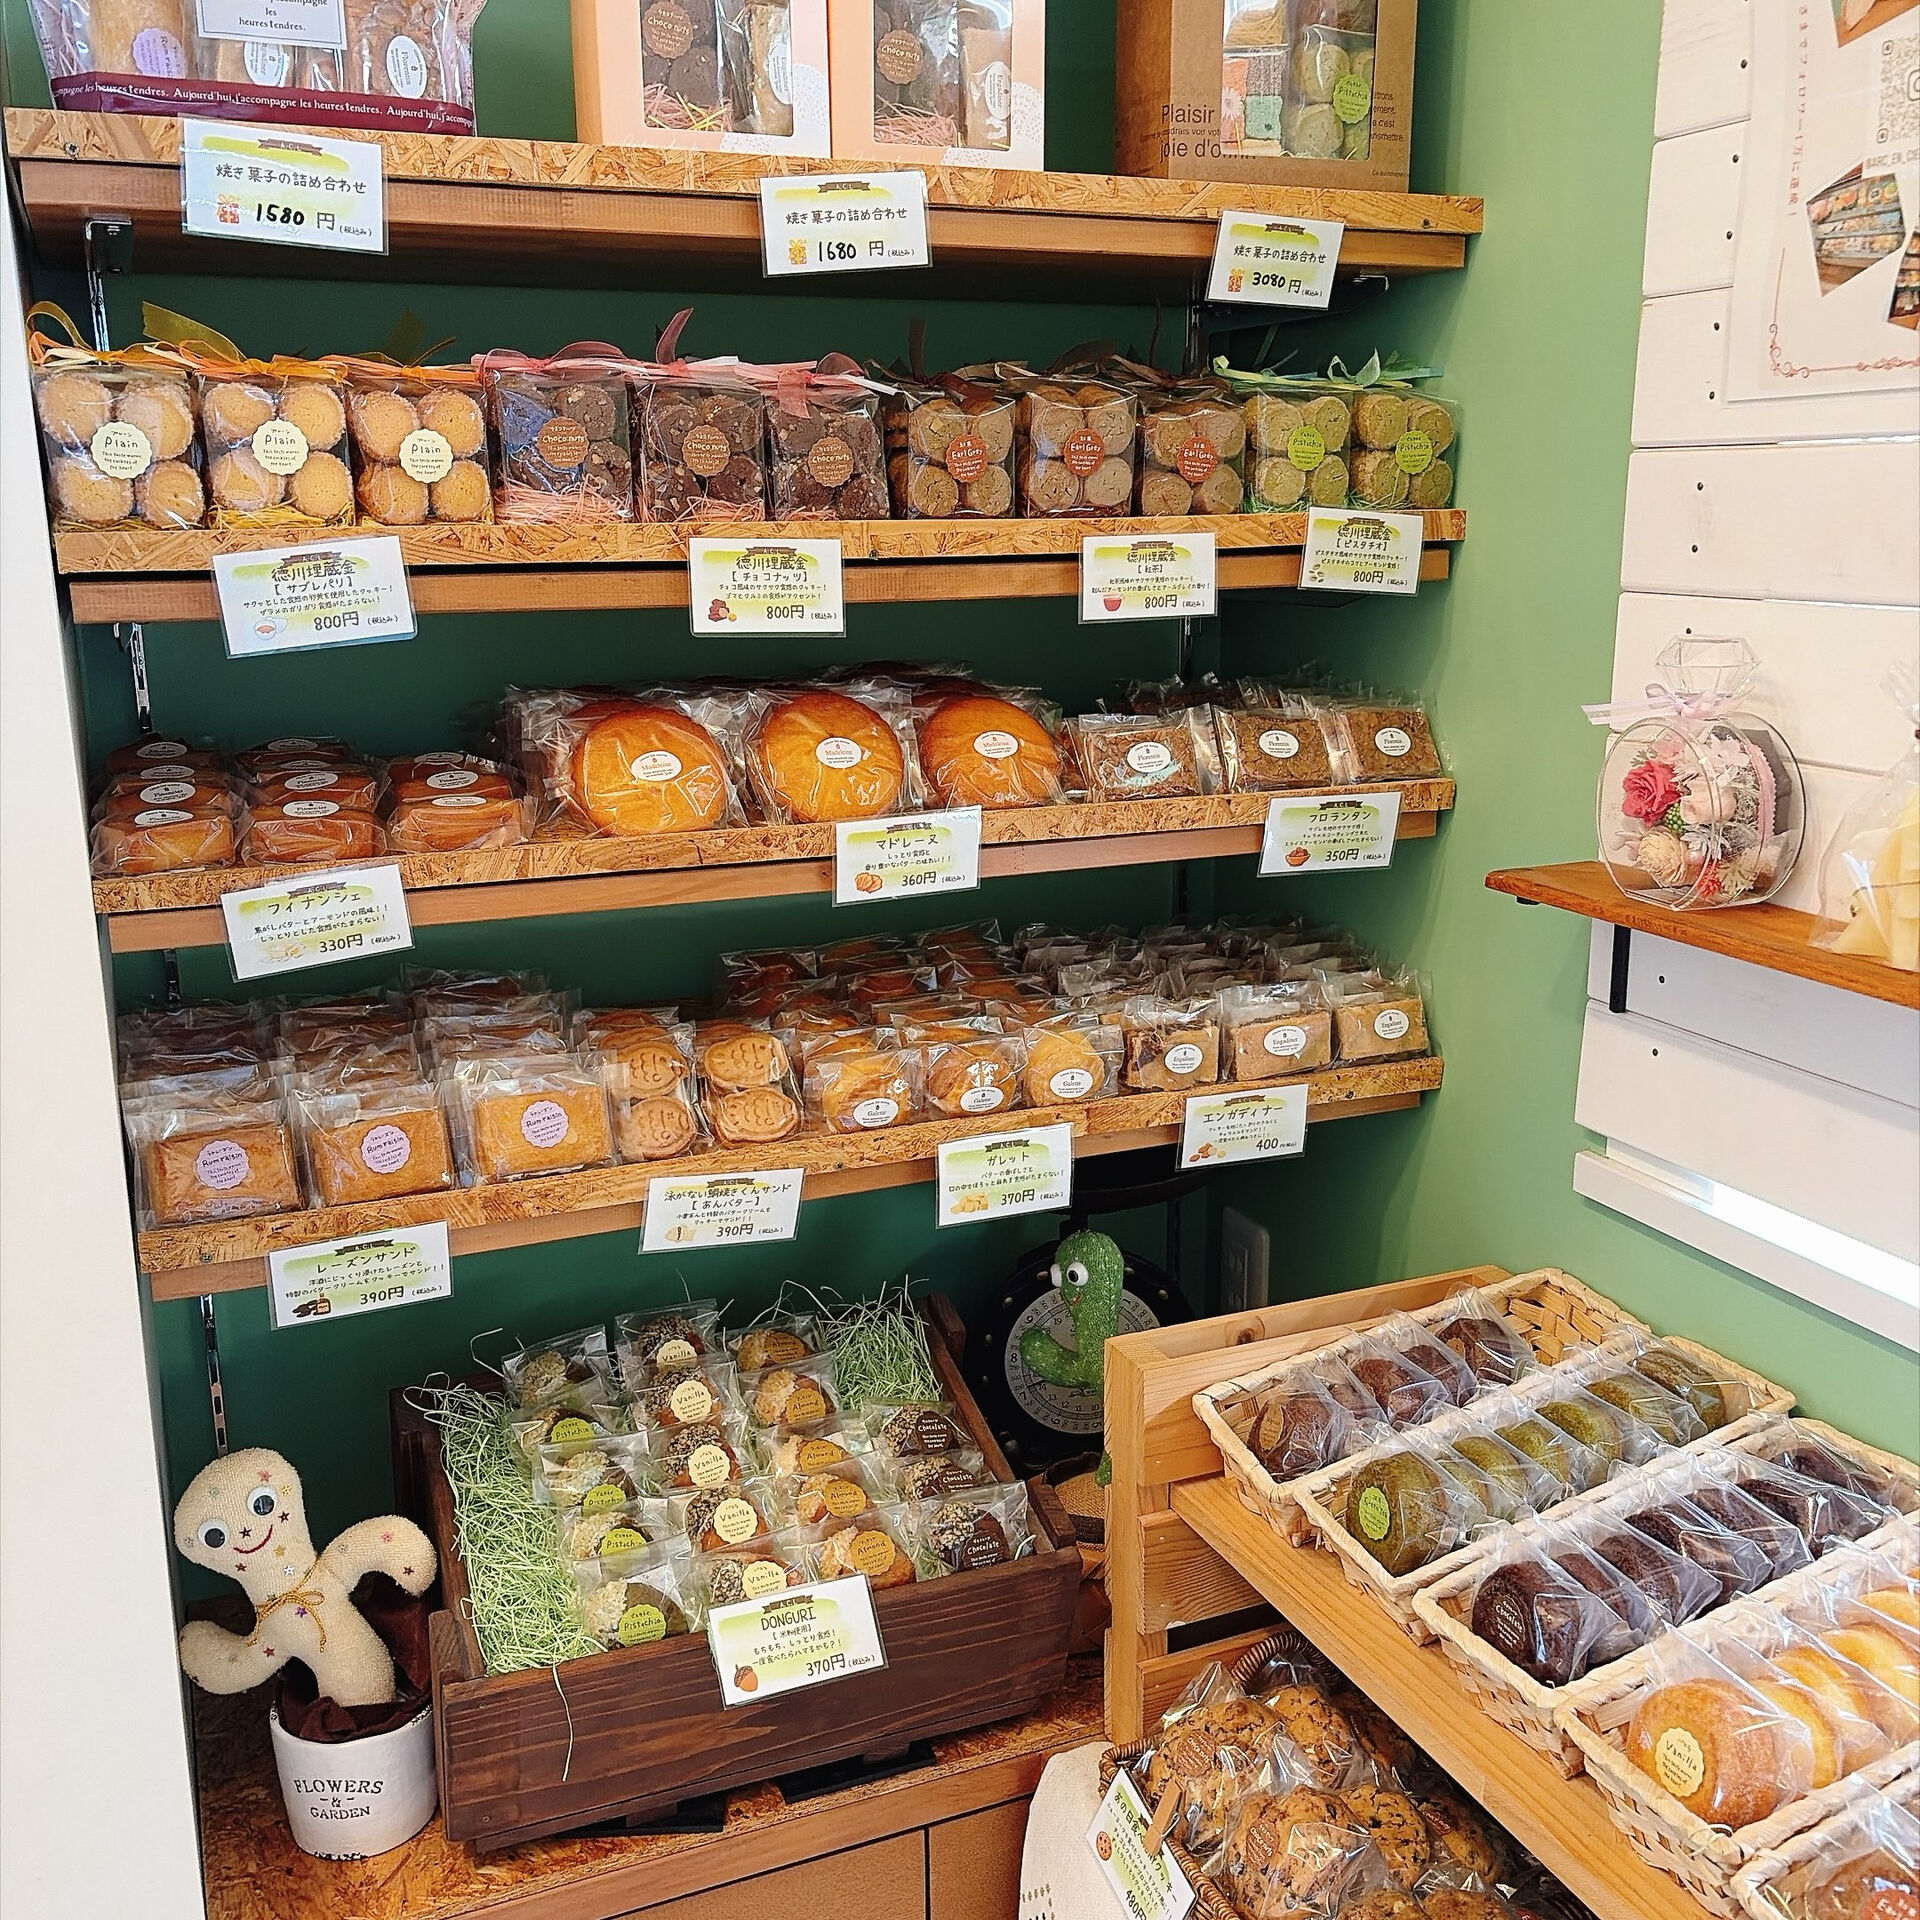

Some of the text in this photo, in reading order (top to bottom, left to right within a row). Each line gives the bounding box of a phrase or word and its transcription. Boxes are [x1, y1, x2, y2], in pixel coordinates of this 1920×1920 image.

[265, 7, 277, 16] les
[239, 17, 306, 31] heures tendres.
[95, 82, 127, 94] heures
[128, 83, 169, 98] tendres.
[299, 98, 312, 109] les
[313, 100, 345, 113] heures
[345, 103, 384, 115] tendres.
[1161, 103, 1215, 124] Plaisir
[1160, 138, 1188, 164] joie
[216, 164, 367, 194] 焼き菓子の詰め合わせ
[256, 203, 305, 226] 1580
[317, 212, 335, 231] 円
[785, 207, 908, 225] 焼き菓子の詰め合わせ
[818, 241, 858, 262] 1680
[868, 240, 884, 257] 円
[1233, 244, 1327, 264] 焼き菓子の詰め合わせ
[1252, 271, 1286, 289] 3080
[1288, 279, 1302, 294] 円
[104, 436, 139, 449] Plain
[263, 435, 297, 446] Plain
[541, 435, 568, 443] Choco
[687, 441, 711, 451] Choco
[410, 443, 442, 455] Plain
[1337, 525, 1393, 541] 徳川埋蔵金
[736, 556, 808, 571] 徳川埋蔵金
[1127, 550, 1178, 563] 徳川埋蔵金
[271, 560, 357, 582] 徳川埋蔵金
[1353, 570, 1384, 584] 800円
[1144, 594, 1178, 609] 800円
[766, 604, 805, 620] 800円
[314, 610, 360, 632] 800円
[1308, 811, 1371, 823] フロランタン
[875, 834, 939, 850] マドレーヌ
[1324, 848, 1359, 862] 350円
[901, 871, 937, 887] 360円
[268, 892, 362, 915] フィナンシェ
[319, 933, 364, 953] 330円
[1203, 1105, 1284, 1123] エンガディナー
[525, 1118, 542, 1129] Rum
[366, 1143, 383, 1155] Rum
[1256, 1137, 1280, 1152] 400
[201, 1156, 219, 1168] Rum
[986, 1152, 1030, 1167] ガレット
[1001, 1189, 1036, 1206] 370円
[717, 1223, 754, 1238] 390円
[316, 1246, 417, 1274] レーズンサンド
[359, 1285, 405, 1305] 390円
[676, 1390, 705, 1404] Vanilla
[693, 1454, 724, 1470] Vanilla
[719, 1508, 751, 1522] Vanilla
[747, 1569, 780, 1585] Vanilla
[760, 1606, 817, 1632] DONGURI
[805, 1652, 846, 1678] 370円
[1665, 1739, 1698, 1772] Vanilla
[292, 1778, 385, 1795] FLOWERS
[309, 1805, 371, 1820] GARDEN
